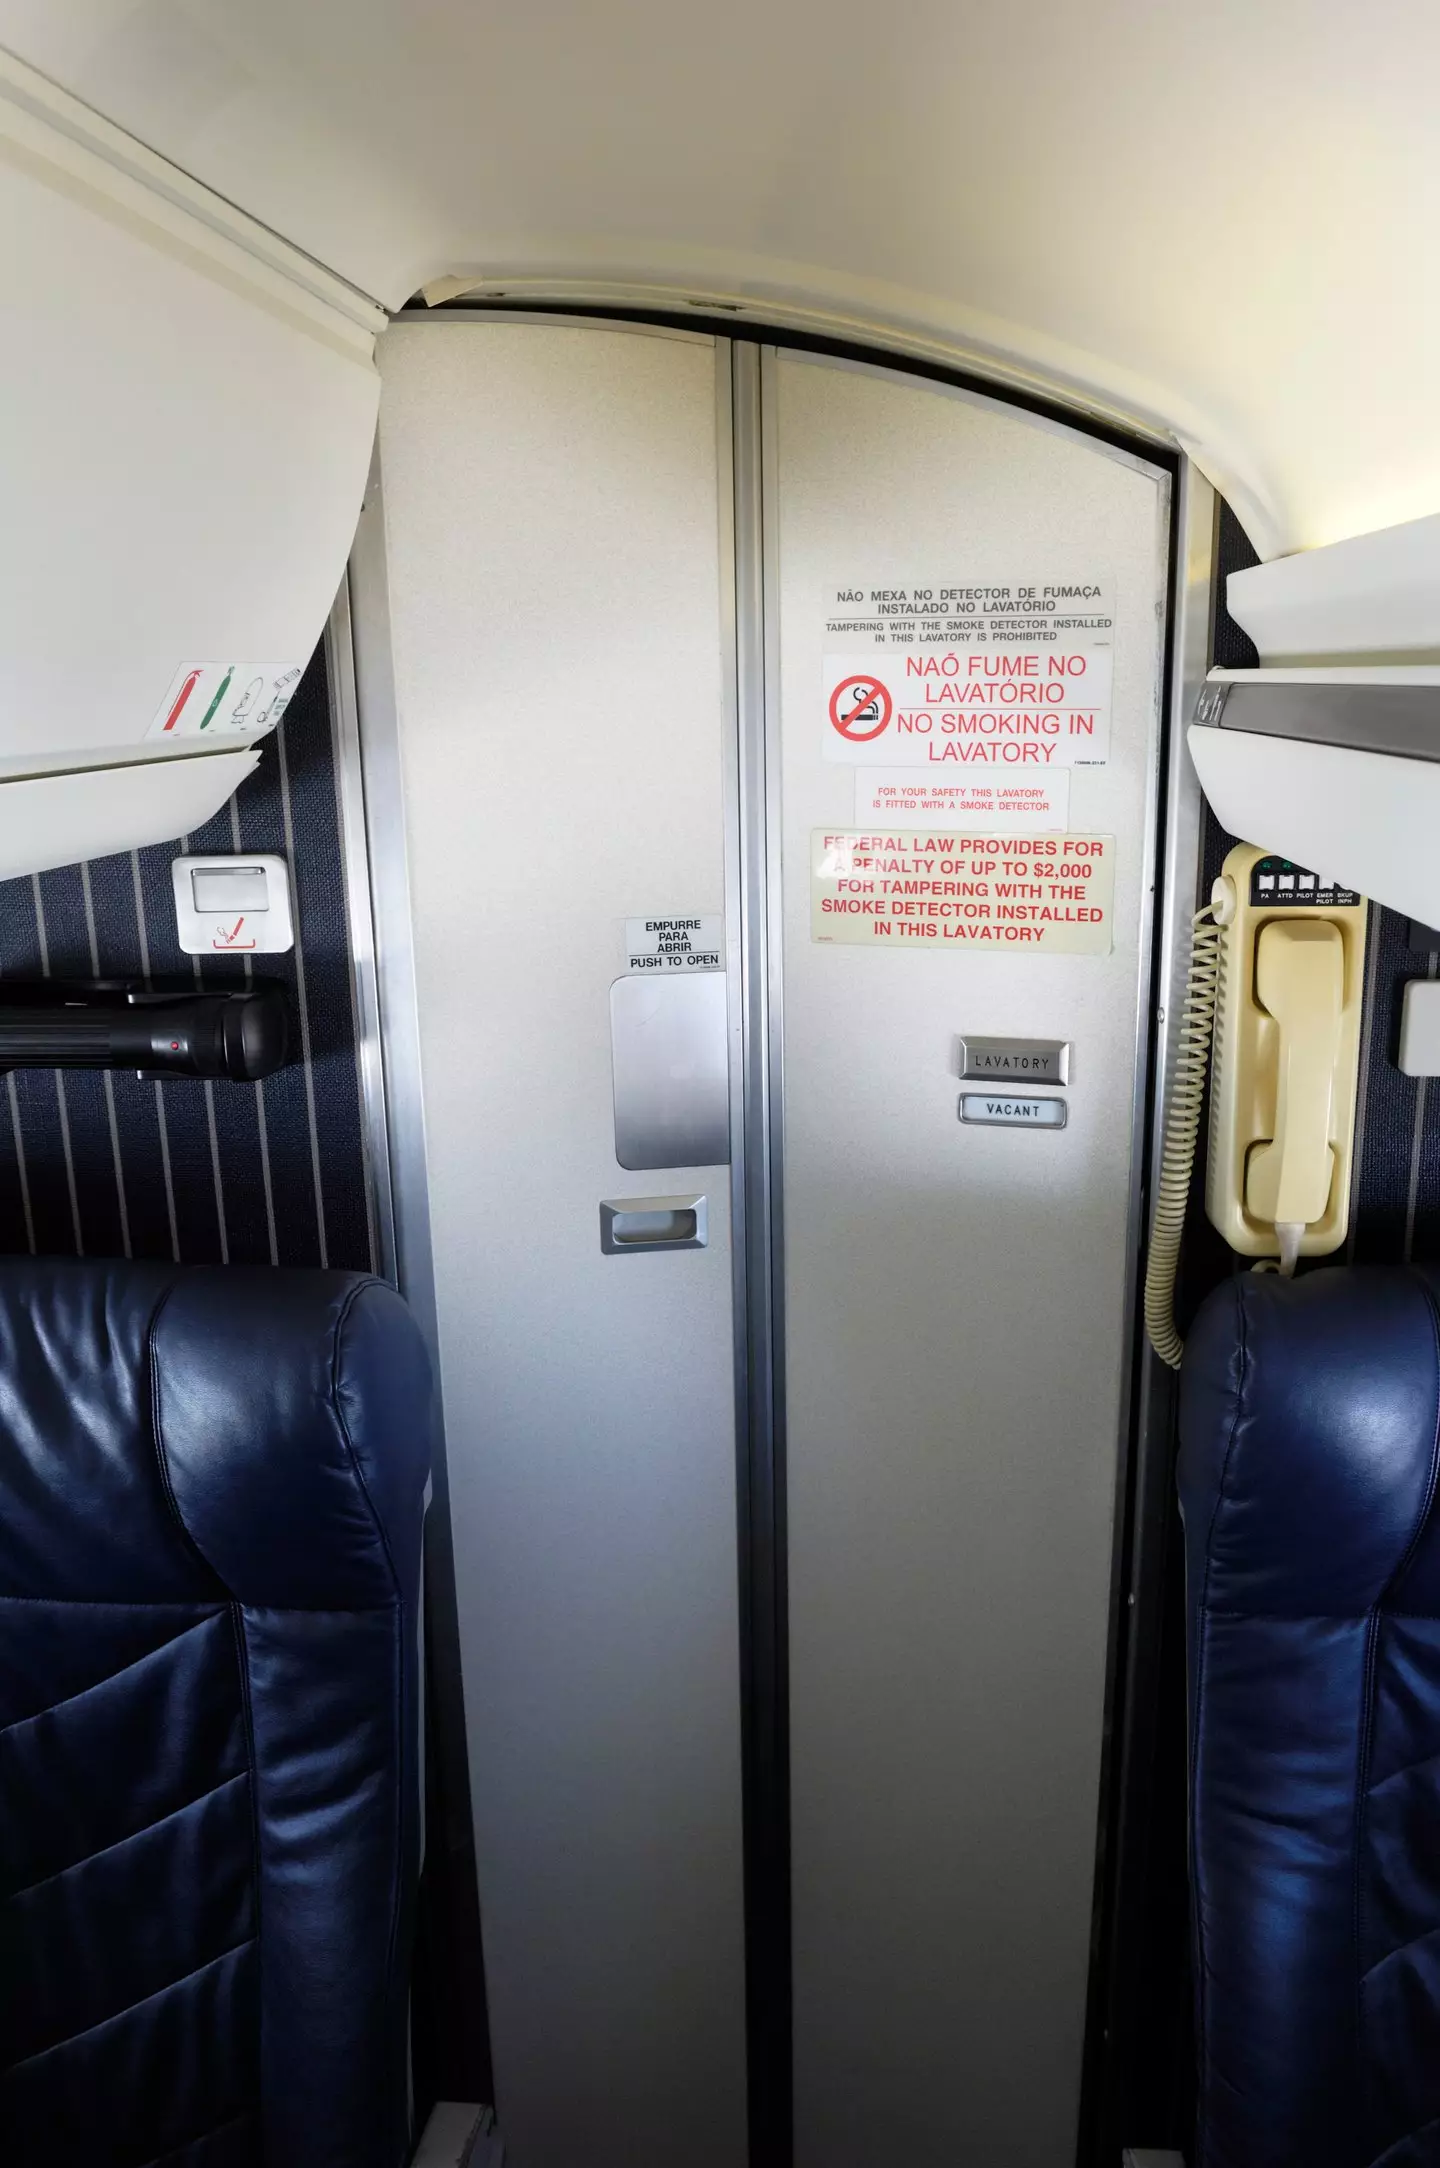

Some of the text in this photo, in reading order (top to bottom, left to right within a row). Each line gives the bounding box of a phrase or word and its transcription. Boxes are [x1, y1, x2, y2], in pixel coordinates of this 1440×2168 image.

[837, 586, 1101, 602] NÃO MEXA NO DETECTOR DE FUMAÇA
[878, 598, 1055, 614] INSTALADO NO LAVATÓRIO
[827, 619, 1112, 632] TAMPERING WITH THE SMOKE DETECTOR INSTALLED
[875, 632, 1057, 642] IN THIS LAVATORY IS PROHIBITED
[968, 656, 1039, 676] FUME
[1049, 656, 1086, 676] NO
[926, 679, 1065, 703] LAVATÓRIO
[897, 714, 1093, 734] NO SMOKING IN
[929, 742, 1057, 762] LAVATORY
[878, 788, 1044, 798] FOR YOUR SAFETY THIS LAVATORY
[873, 800, 1049, 811] IS FITTED WITH A SMOKE DETECTOR
[824, 836, 1103, 857] FEDERAL LAW PROVIDES FOR
[853, 859, 934, 874] PENALTY
[941, 860, 966, 874] OF
[971, 861, 996, 876] UP
[1002, 862, 1027, 876] TO
[1033, 863, 1092, 880] $2,000
[838, 879, 1085, 900] FOR TAMPERING WITH THE
[822, 899, 1103, 922] SMOKE DETECTOR INSTALLED
[646, 920, 701, 931] EMPURRE
[874, 921, 1044, 941] IN THIS LAVATORY
[659, 932, 689, 941] PARA
[658, 942, 691, 952] ABRIR
[631, 955, 718, 967] PUSH TO OPEN
[975, 1056, 1049, 1069] LAVATORY
[987, 1103, 1039, 1116] VACANT
